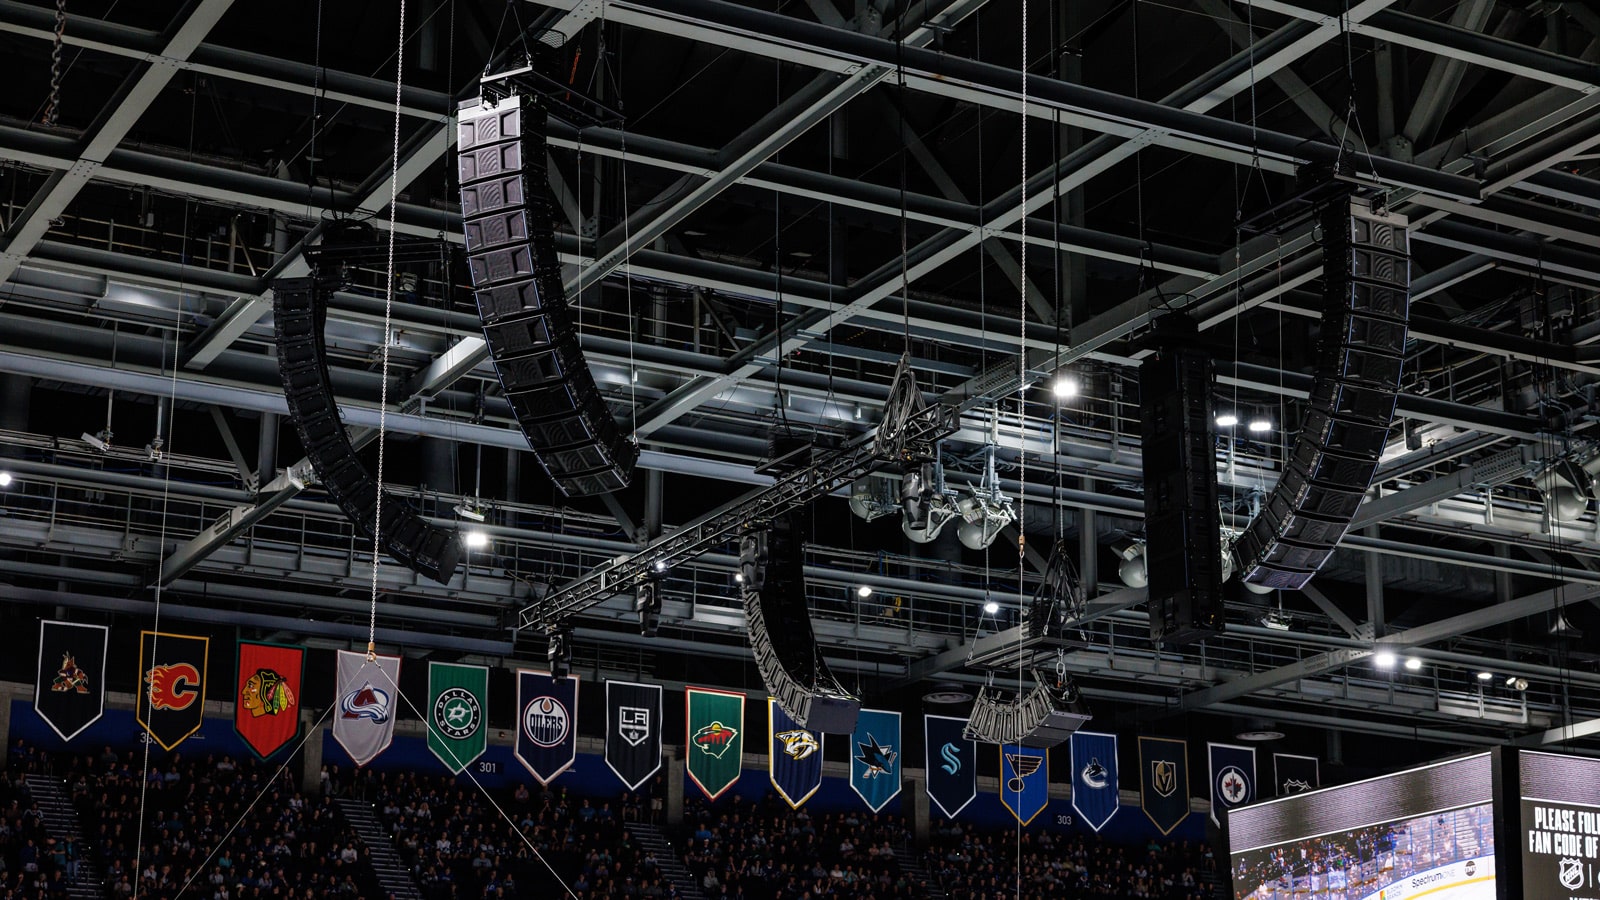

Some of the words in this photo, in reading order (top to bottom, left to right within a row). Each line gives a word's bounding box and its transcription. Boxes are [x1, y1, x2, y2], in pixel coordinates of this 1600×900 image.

[438, 691, 478, 711] DALLAS
[529, 713, 563, 731] OILERS
[622, 711, 647, 725] LA
[439, 720, 476, 736] STARS
[479, 762, 496, 773] 301
[1057, 815, 1072, 825] 303
[1534, 806, 1576, 832] PLEASE
[1528, 830, 1552, 854] FAN
[1554, 833, 1583, 857] CODE
[1585, 836, 1599, 858] OF
